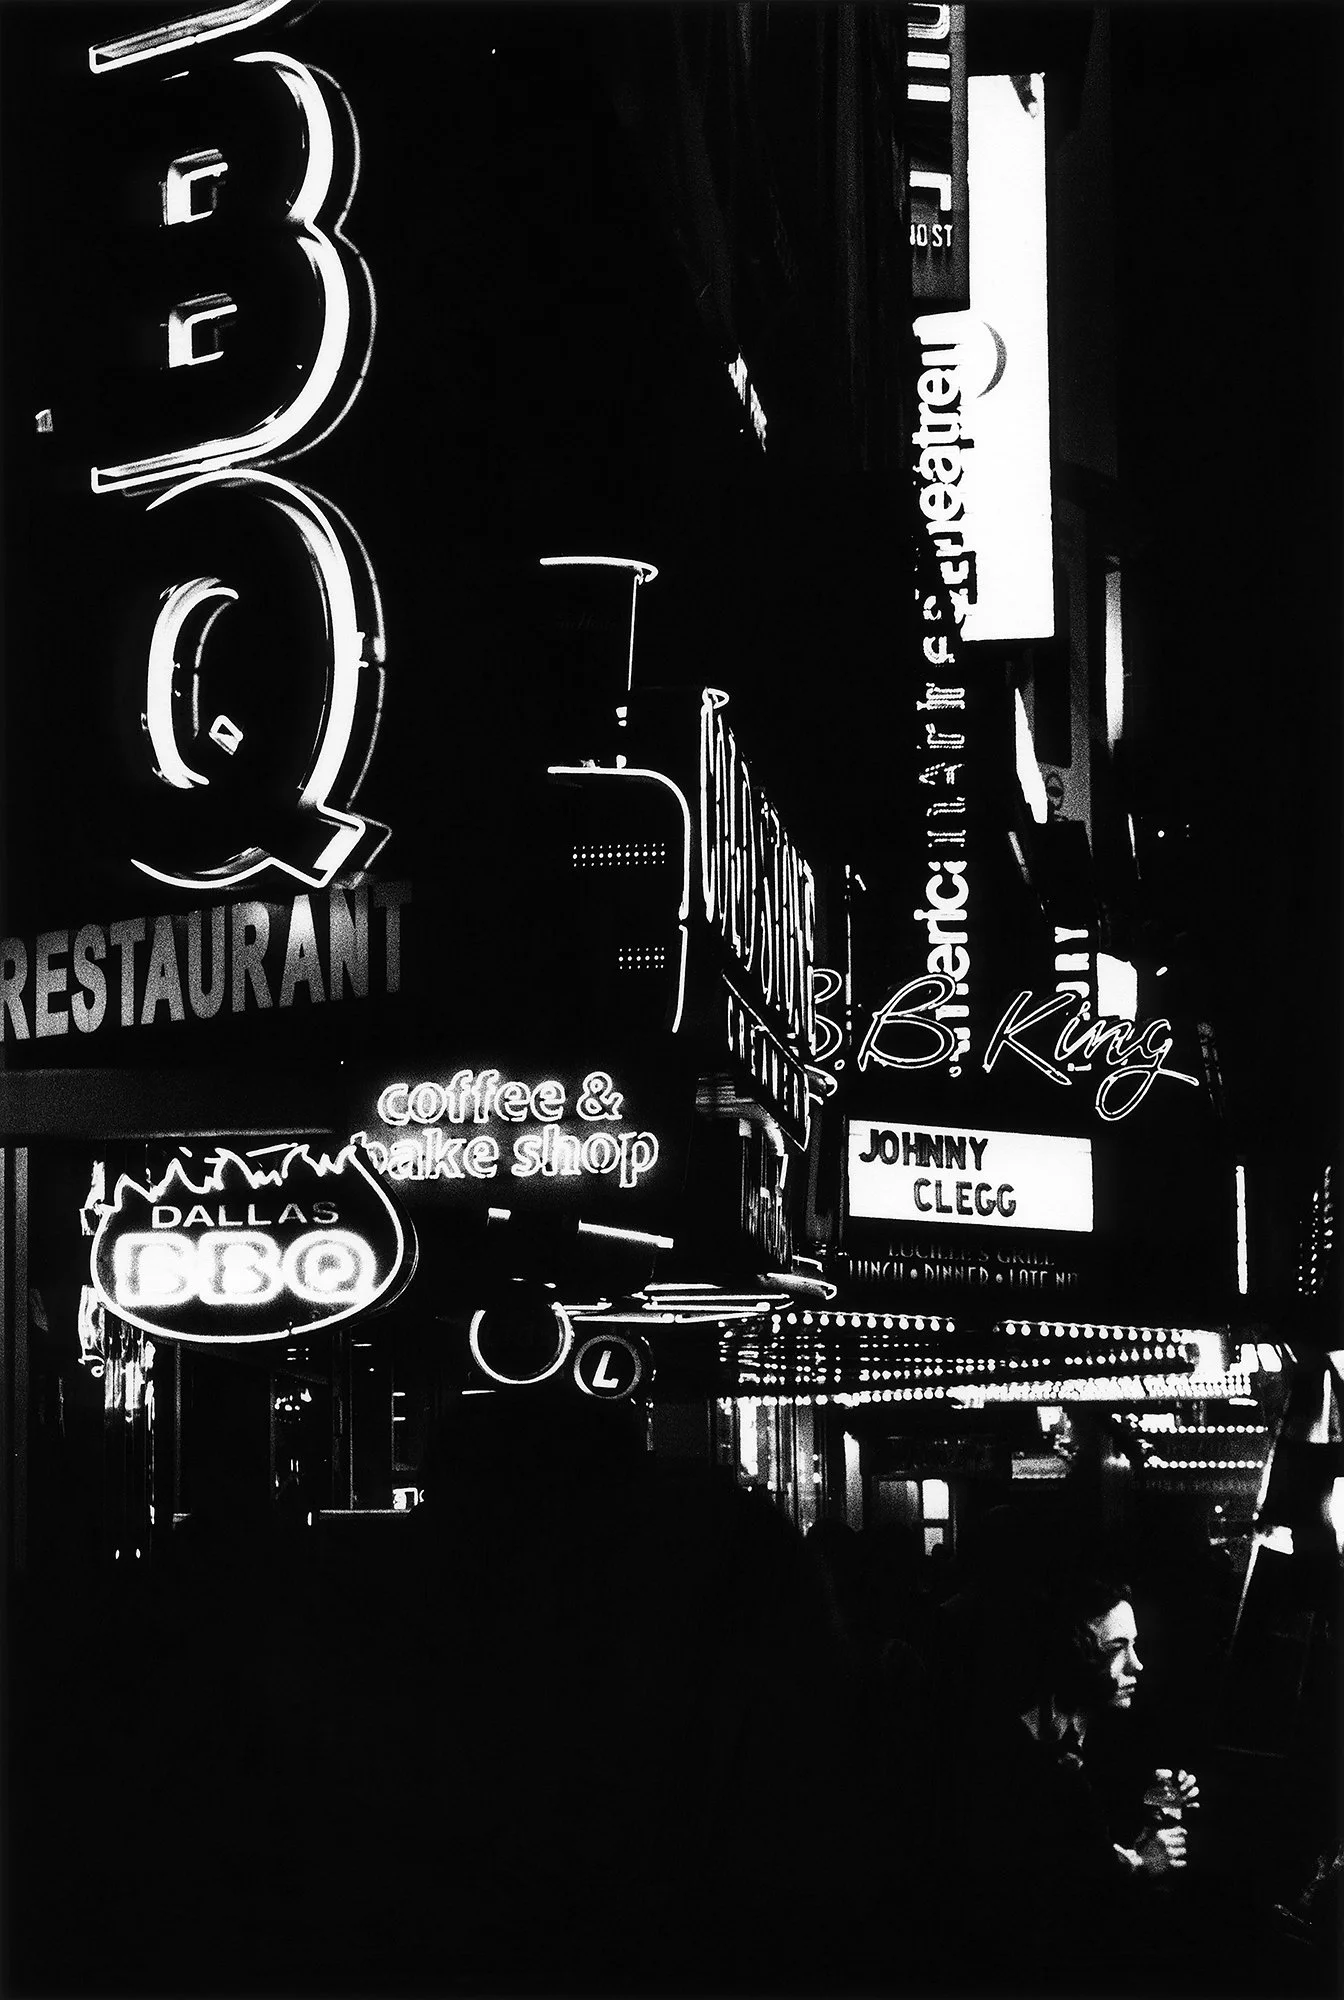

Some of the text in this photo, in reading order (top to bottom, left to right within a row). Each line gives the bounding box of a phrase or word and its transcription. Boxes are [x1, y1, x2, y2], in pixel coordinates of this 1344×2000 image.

[88, 0, 393, 891] BQ
[0, 881, 412, 1042] RESTAURANT
[982, 990, 1200, 1122] King
[377, 1069, 624, 1126] coffee &
[511, 1123, 659, 1188] shop
[858, 1128, 989, 1172] JOHNNY
[151, 1200, 340, 1229] DALLAS
[913, 1177, 1017, 1218] CLEGG
[113, 1229, 378, 1307] BBQ
